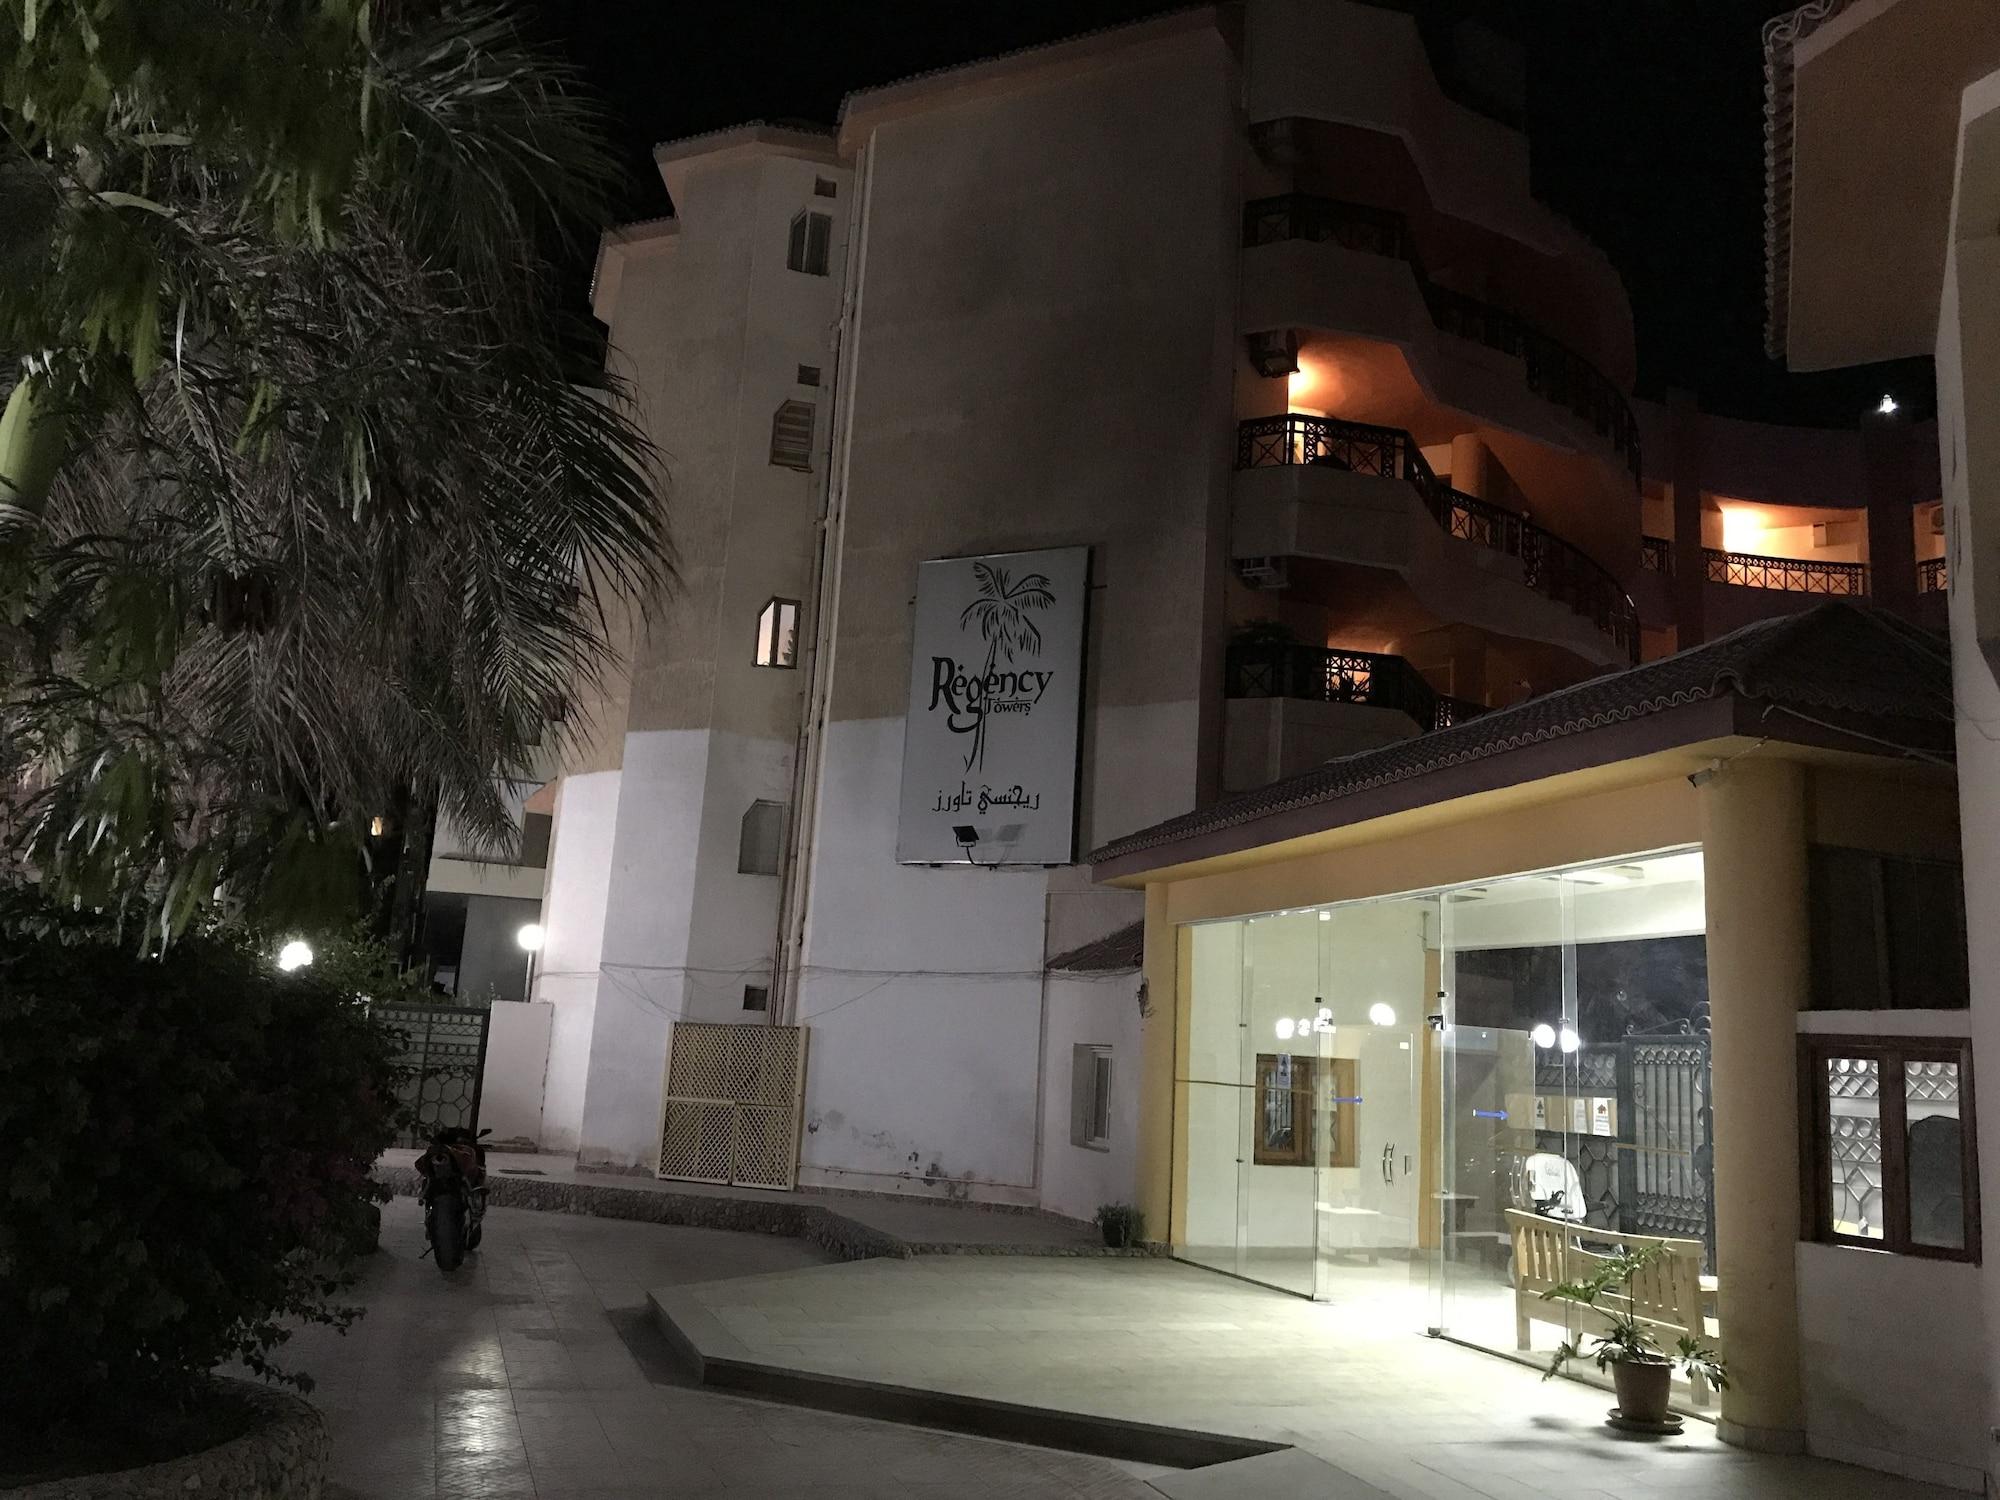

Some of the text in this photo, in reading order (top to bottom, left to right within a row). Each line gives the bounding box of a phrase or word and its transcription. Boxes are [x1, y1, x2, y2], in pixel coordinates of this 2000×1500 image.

[929, 656, 1054, 733] Regency
[983, 697, 1032, 716] Towers
[932, 780, 972, 812] تاورز
